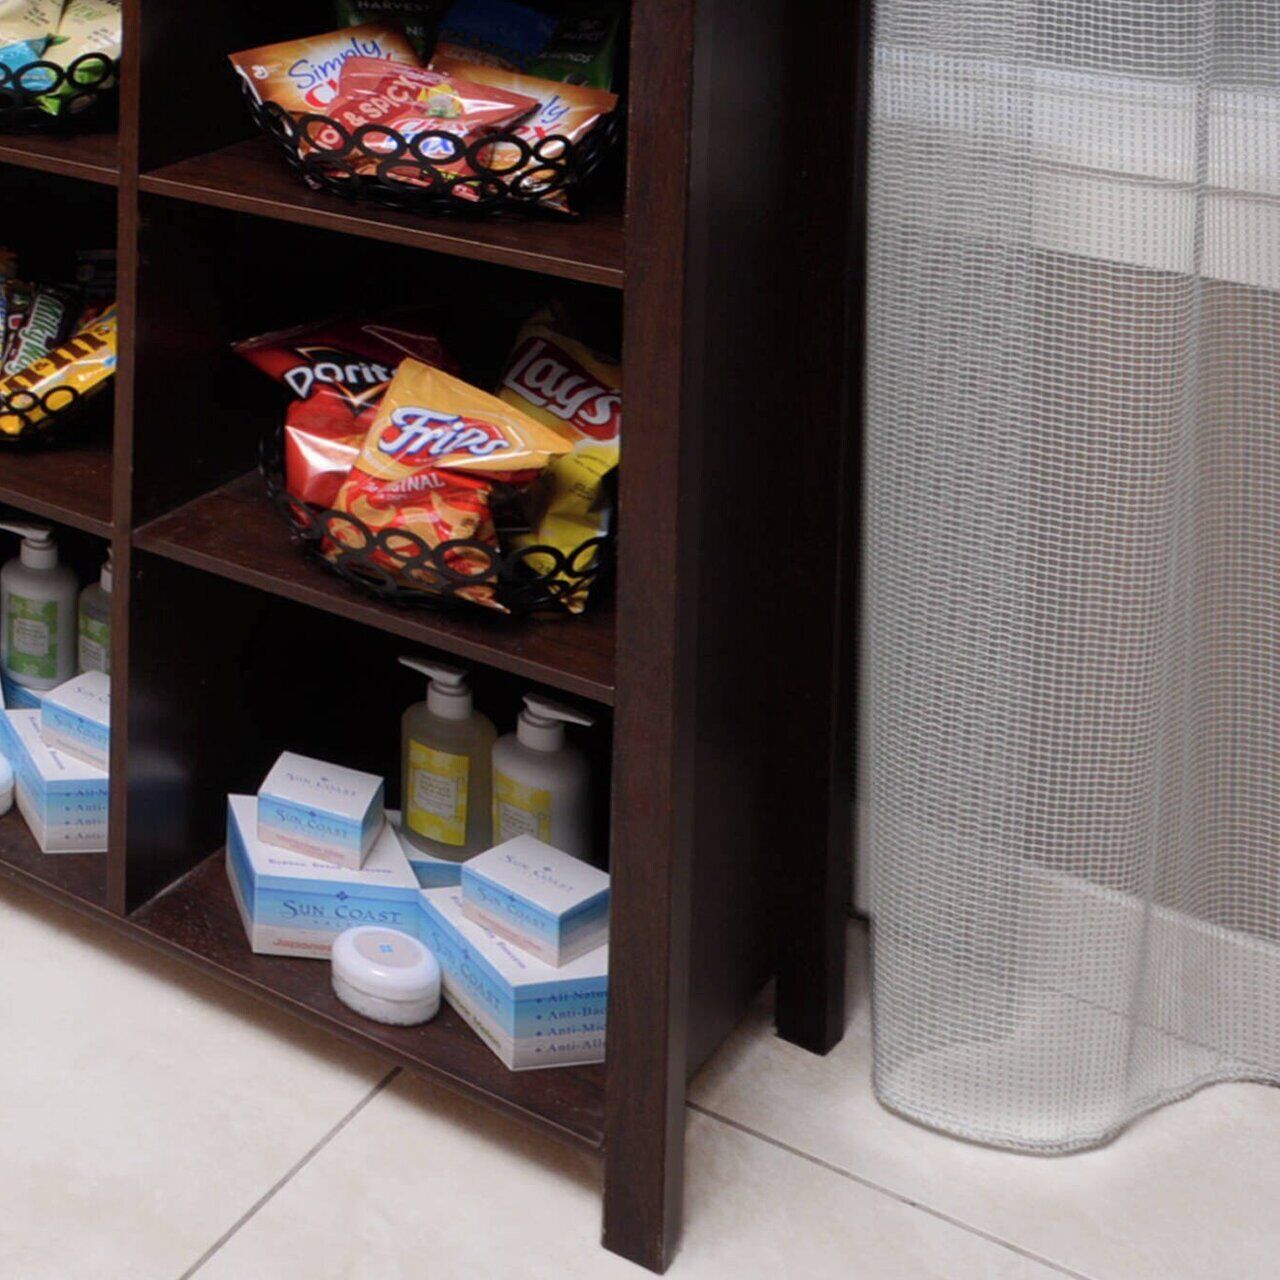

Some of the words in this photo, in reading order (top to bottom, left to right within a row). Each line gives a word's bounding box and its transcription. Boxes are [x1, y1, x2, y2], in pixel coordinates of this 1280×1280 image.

[358, 71, 421, 121] SPICY
[284, 361, 400, 399] Dorit
[378, 406, 510, 456] Frios
[547, 1006, 606, 1019] Anti-Bac
[547, 1022, 606, 1037] Anti-Mic
